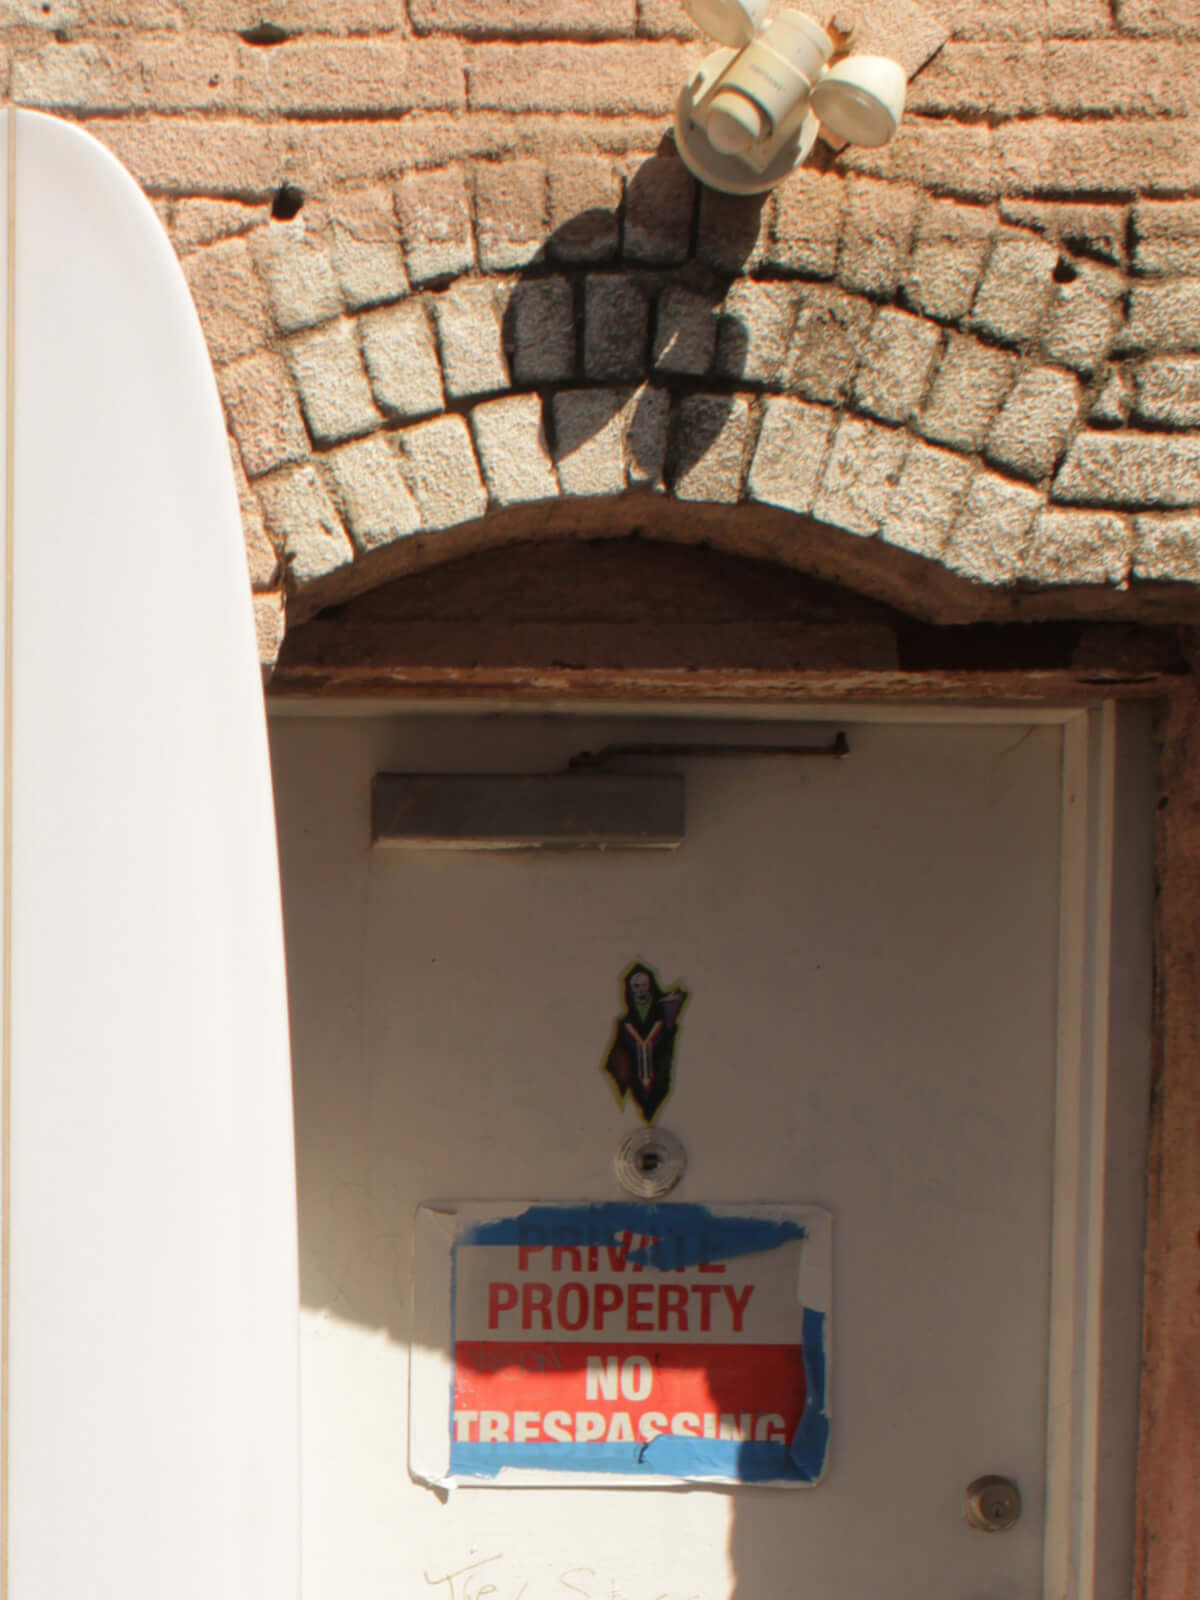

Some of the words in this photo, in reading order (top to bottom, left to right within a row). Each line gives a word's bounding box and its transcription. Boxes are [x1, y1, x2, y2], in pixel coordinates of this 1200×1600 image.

[517, 1227, 727, 1273] PRIV
[487, 1281, 755, 1333] PROPERTY
[585, 1355, 653, 1402] NO
[454, 1410, 787, 1445] TRESPASSING
